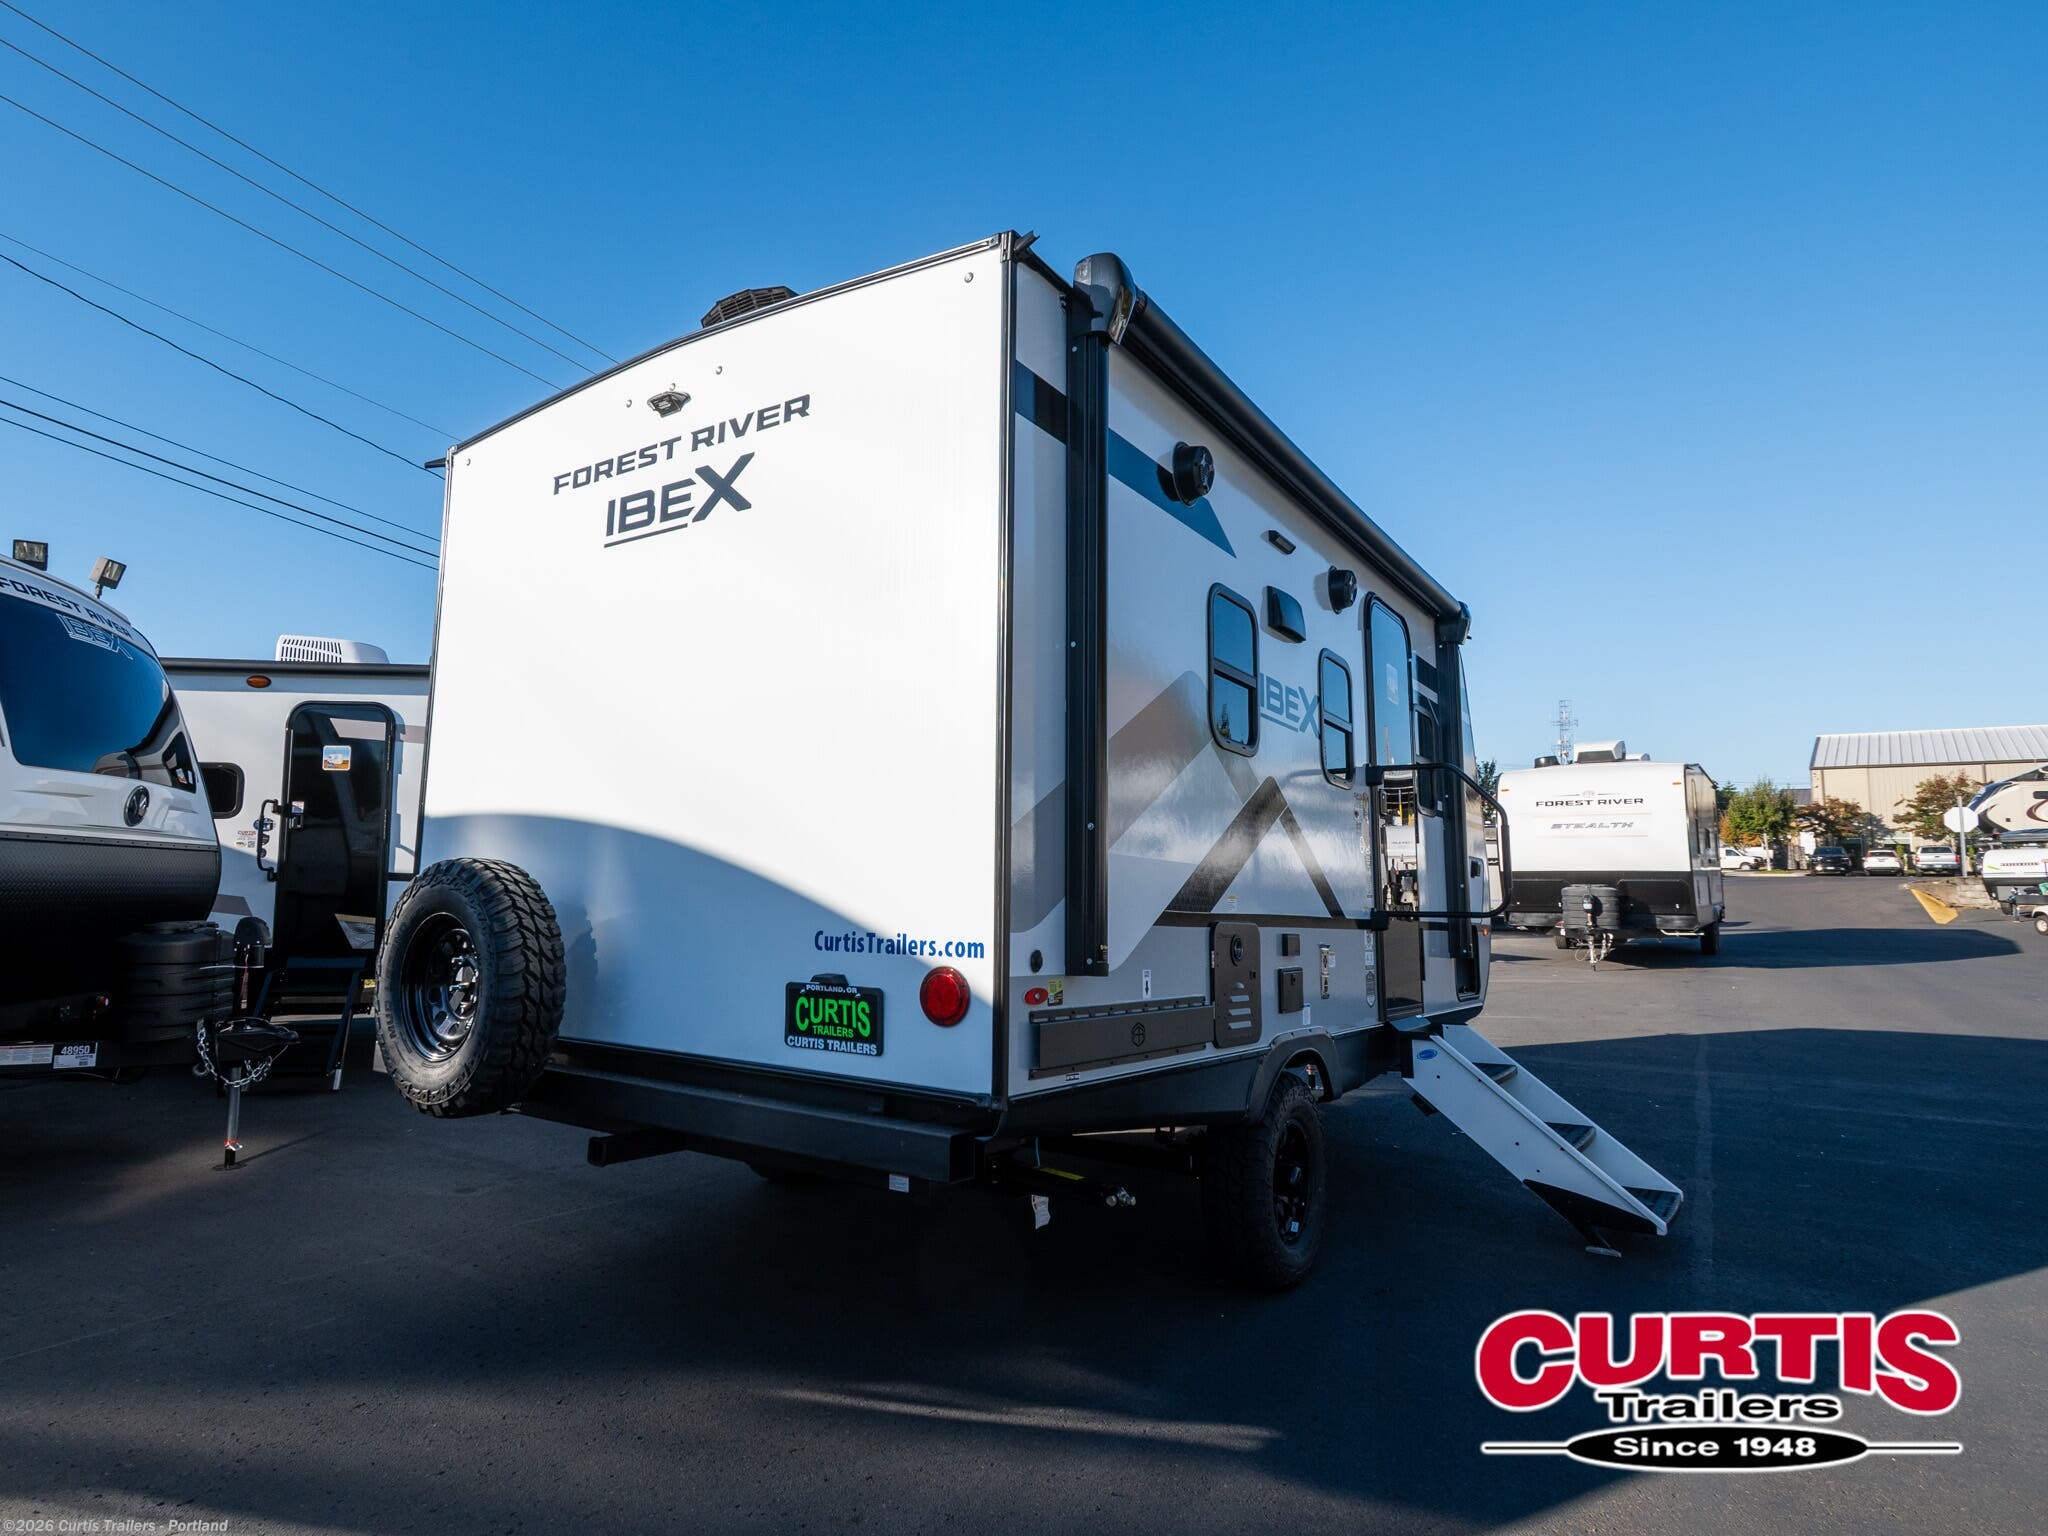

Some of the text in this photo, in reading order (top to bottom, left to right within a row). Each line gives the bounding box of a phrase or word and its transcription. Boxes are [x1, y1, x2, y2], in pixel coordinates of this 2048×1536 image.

[553, 393, 811, 496] FOREST RIVER
[605, 451, 756, 537] IBEX
[83, 606, 134, 640] RIVER
[1259, 671, 1319, 739] IBEX
[1535, 799, 1593, 807] FOREST
[1550, 822, 1634, 830] STEALTH
[814, 930, 985, 959] CurtisTrailers.com
[846, 986, 858, 995] OR
[795, 996, 871, 1038] CURTIS
[812, 1024, 854, 1038] TRAILERS
[60, 1045, 91, 1055] 48950
[787, 1035, 878, 1056] CURTIS TRAILERS
